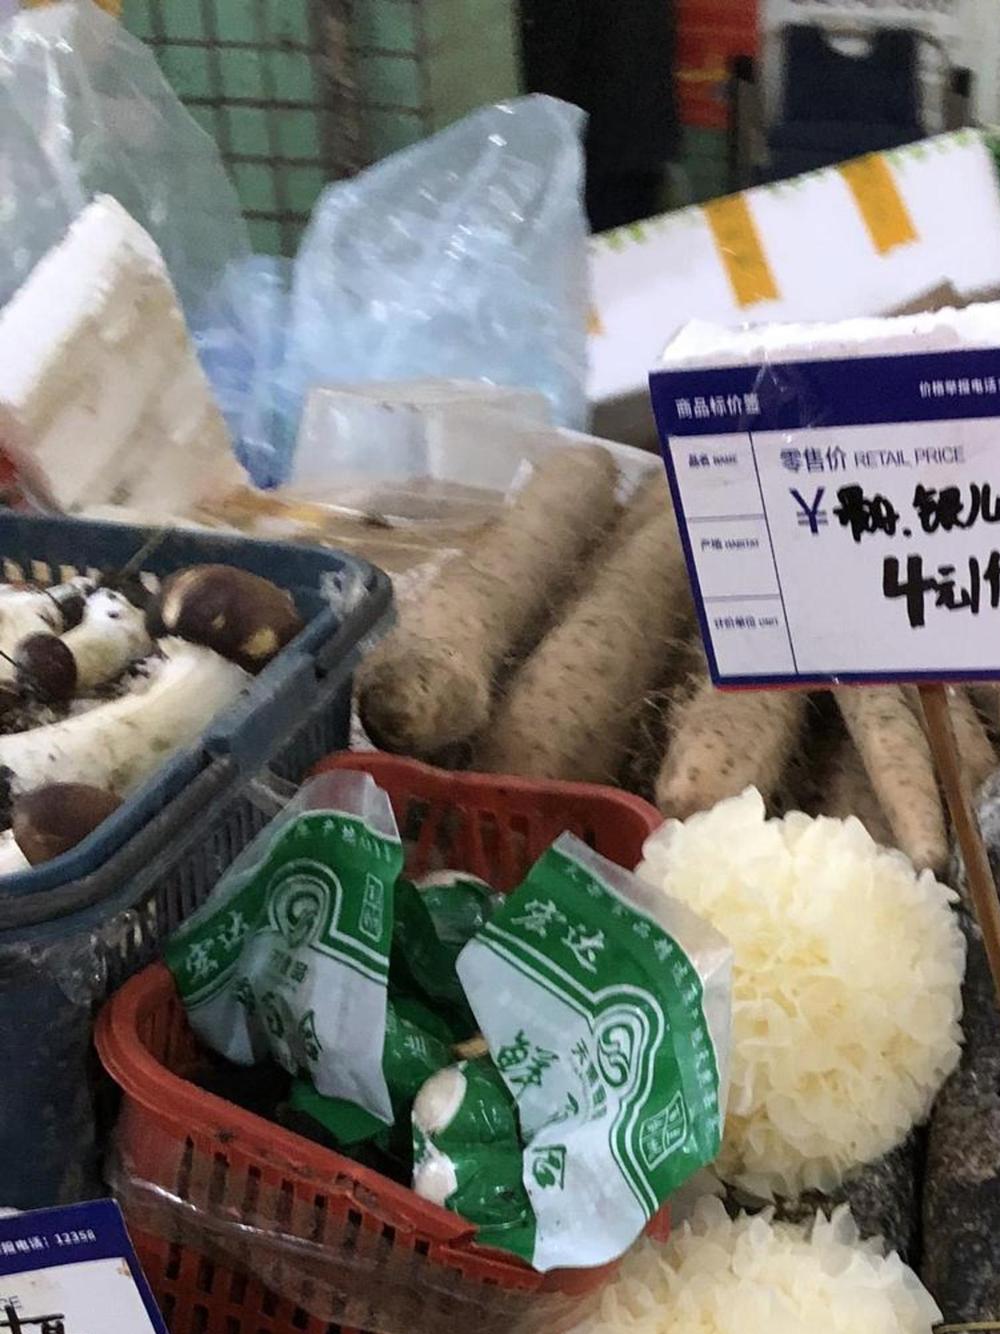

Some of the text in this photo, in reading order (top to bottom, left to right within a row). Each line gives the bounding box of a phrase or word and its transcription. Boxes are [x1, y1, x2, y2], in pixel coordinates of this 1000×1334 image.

[780, 444, 966, 473] 零售价 RETAIL PRICE
[54, 1227, 97, 1247] 12358
